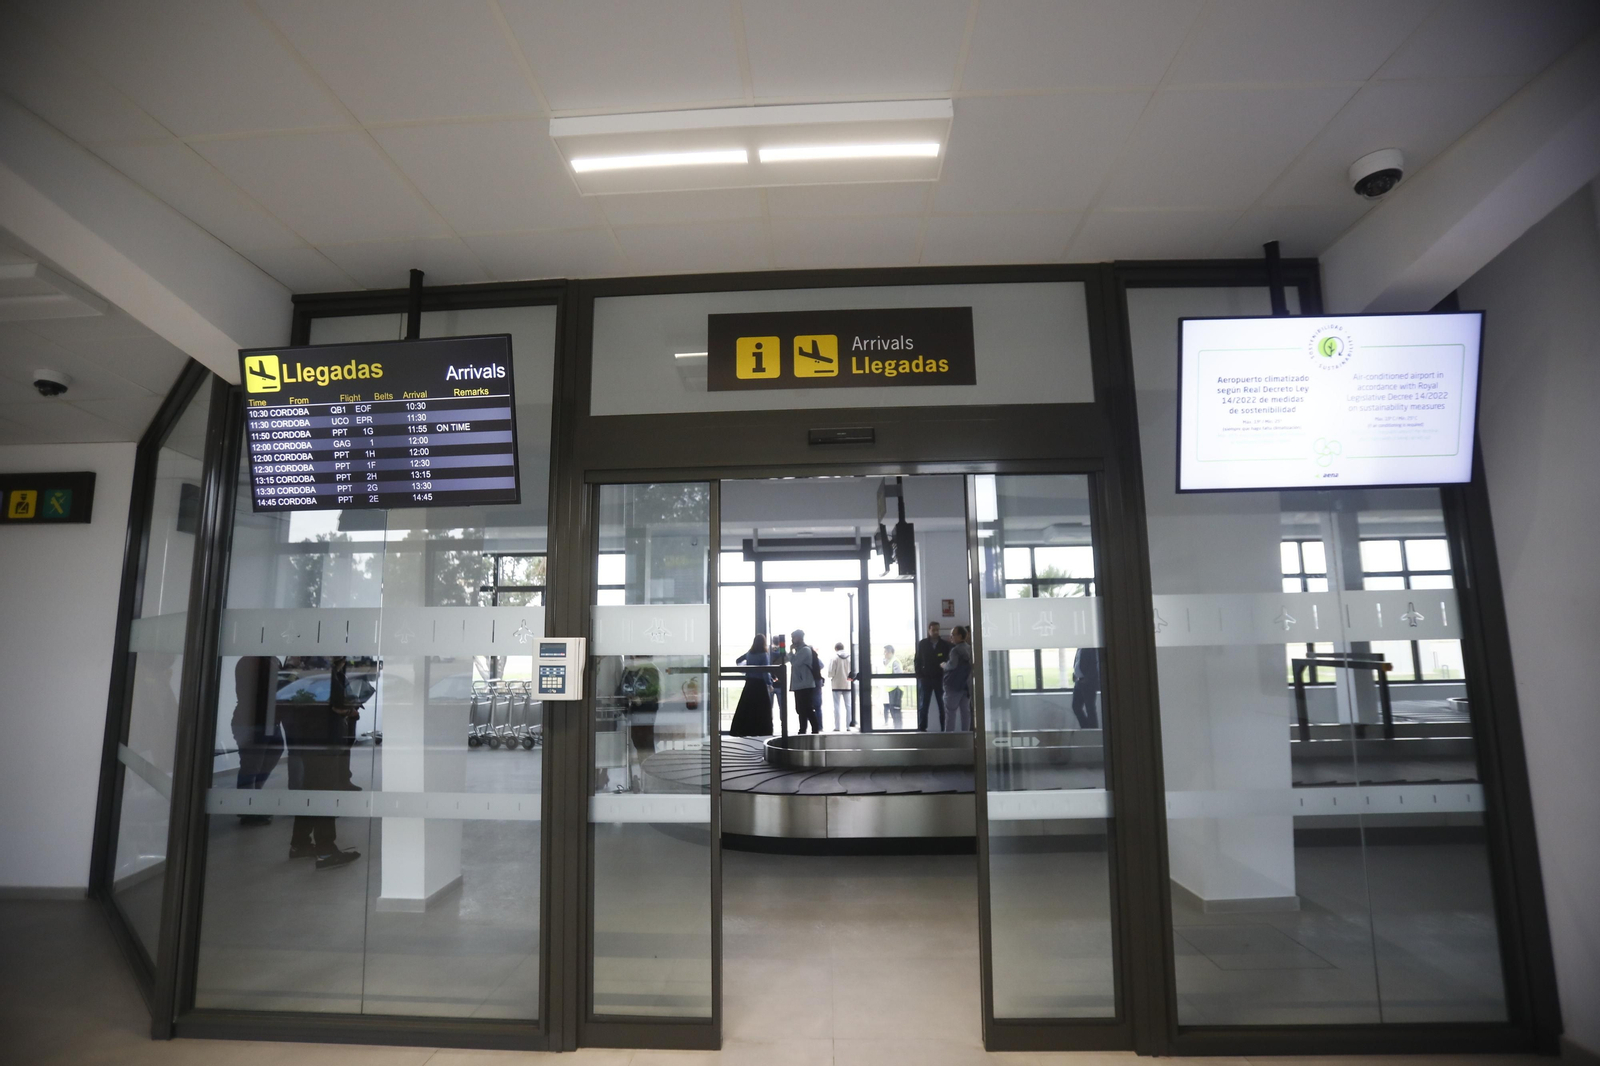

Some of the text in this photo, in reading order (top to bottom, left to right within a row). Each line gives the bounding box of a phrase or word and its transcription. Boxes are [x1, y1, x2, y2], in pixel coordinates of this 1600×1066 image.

[852, 335, 914, 351] Arrivals
[851, 355, 949, 377] Llegadas
[282, 360, 506, 386] Llegadas Arrivals
[1217, 374, 1309, 384] Aeropuerto climatizado
[1353, 370, 1444, 381] Air-conditioned airport in
[1217, 384, 1309, 396] según Real Decreto Ley
[1399, 382, 1416, 390] with
[1417, 381, 1438, 391] Royal
[289, 397, 310, 405] From
[340, 394, 361, 403] Flight
[374, 392, 393, 400] Belts
[403, 390, 427, 399] Arrival
[454, 388, 489, 396] Remarks
[1222, 395, 1304, 405] 14/2022 de medidas
[1346, 391, 1449, 403] Legislative Decree 14/2022
[270, 408, 310, 416] CORDOBA
[330, 406, 346, 414] QB1
[355, 405, 372, 413] EOF
[406, 402, 426, 410] 10:30
[1241, 405, 1297, 414] sostenibilidad
[1359, 403, 1408, 413] sustainability
[1410, 402, 1446, 410] measures
[250, 421, 269, 429] 11:30
[271, 419, 310, 428] CORDOBA
[331, 417, 349, 425] UCO
[356, 416, 373, 424] EPR
[272, 431, 311, 439] CORDOBA
[332, 429, 348, 437] PPT
[363, 427, 374, 435] 1G
[408, 425, 427, 433] 11:55
[436, 424, 448, 432] ON
[451, 423, 470, 431] TIME
[273, 442, 312, 450] CORDOBA
[333, 440, 351, 448] GAG
[274, 453, 313, 462] CORDOBA
[334, 451, 349, 459] PPT
[409, 448, 429, 456] 12:00
[275, 464, 314, 473] CORDOBA
[410, 459, 430, 467] 12:30
[276, 475, 315, 484] CORDOBA
[277, 486, 316, 495] CORDOBA
[412, 482, 431, 490] 13:30
[278, 497, 317, 506] CORDOBA
[338, 496, 353, 504] PPT
[369, 495, 379, 503] 2E
[413, 493, 433, 501] 14:45
